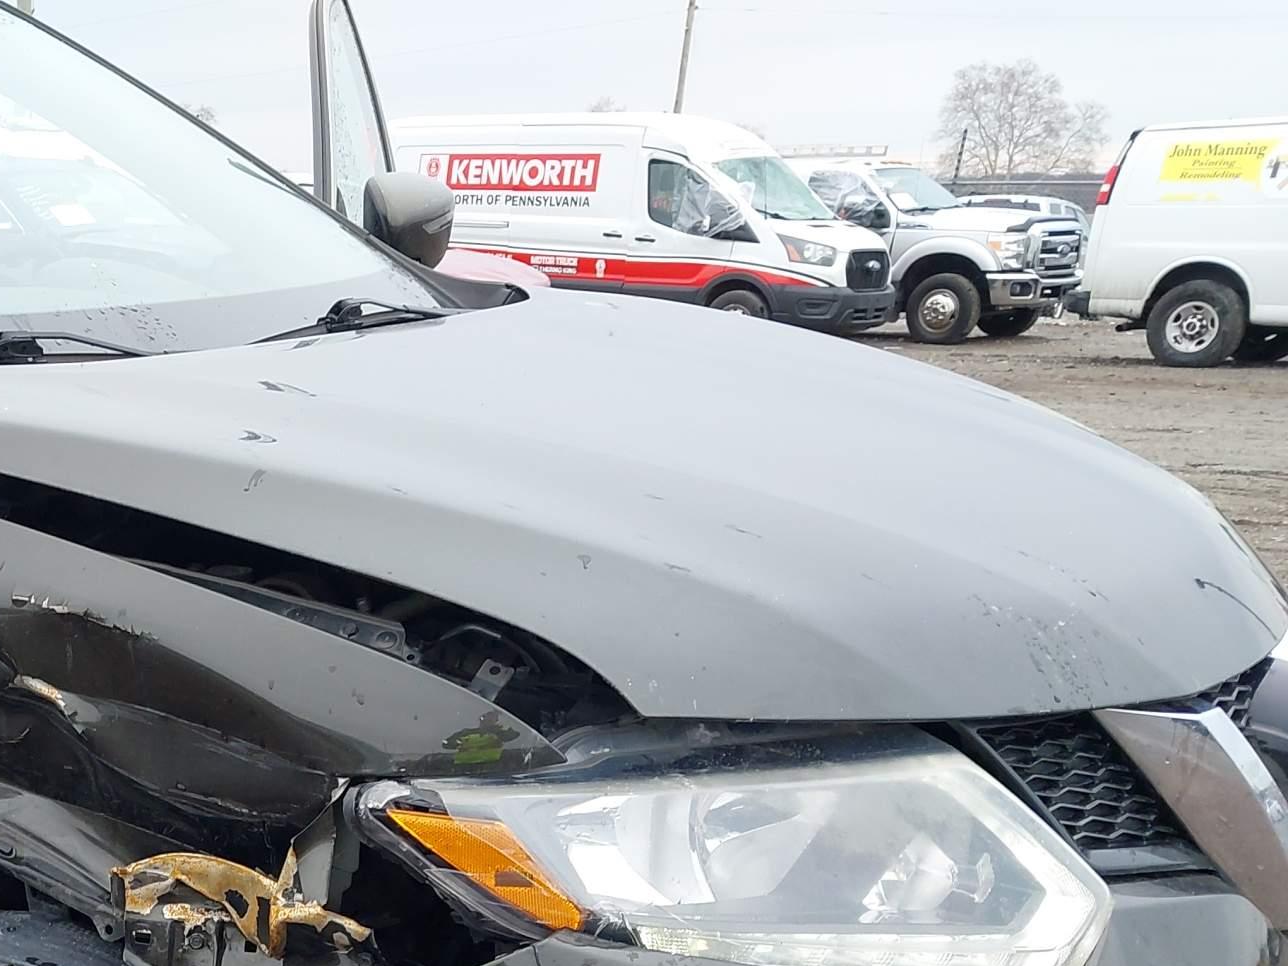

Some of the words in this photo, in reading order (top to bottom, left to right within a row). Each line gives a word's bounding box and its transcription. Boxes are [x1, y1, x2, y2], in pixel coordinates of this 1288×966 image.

[1169, 144, 1202, 158] John
[1206, 142, 1268, 159] Manning
[450, 158, 595, 187] KENWORTH
[454, 194, 483, 206] ORTH
[487, 194, 501, 206] OF
[505, 195, 590, 208] PENNSYLVANIA
